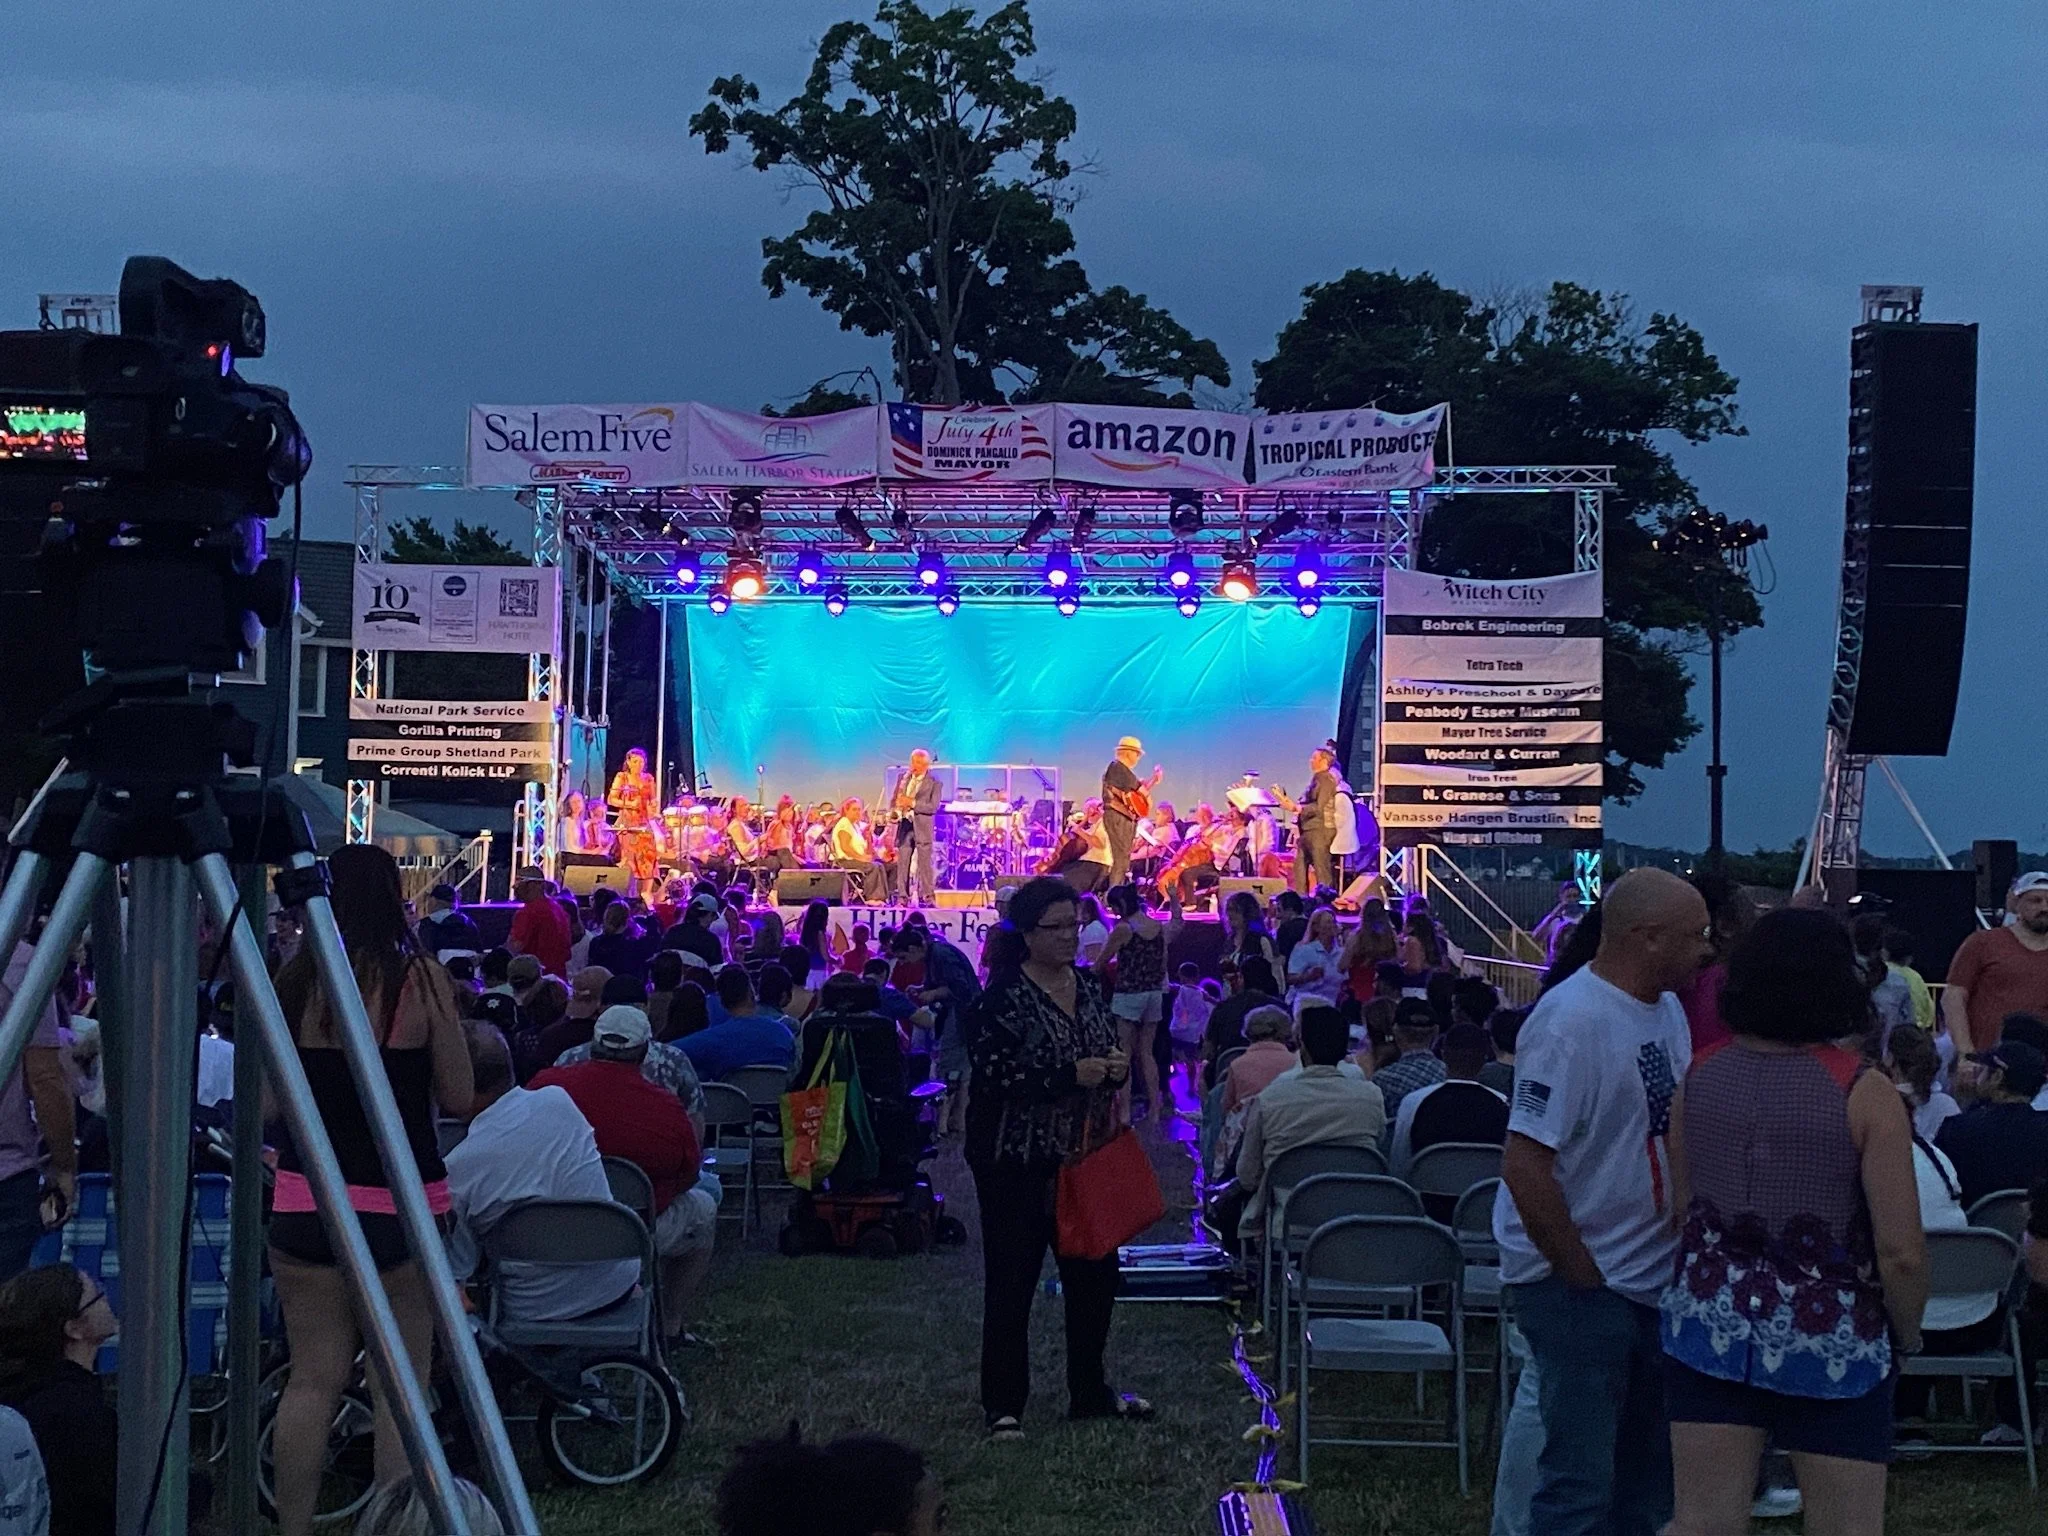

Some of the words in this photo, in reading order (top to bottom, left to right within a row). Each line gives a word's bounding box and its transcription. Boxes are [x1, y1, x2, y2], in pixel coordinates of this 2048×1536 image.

[484, 411, 673, 453] SalemFive
[927, 416, 974, 445] July
[979, 420, 1017, 446] 4th
[1066, 418, 1237, 462] amazon
[927, 446, 972, 458] DOMINICK
[974, 446, 1018, 459] PANGALLO
[1259, 439, 1347, 465] TROPICAL
[692, 463, 738, 478] SALEM
[745, 464, 803, 479] HARBOR
[810, 465, 872, 479] STATION
[934, 459, 1010, 469] MAYOR
[1316, 466, 1361, 477] Eastern
[1364, 463, 1399, 475] Bank
[1448, 584, 1502, 600] Witch
[1507, 584, 1549, 601] City
[1421, 619, 1475, 631] Bobrek
[1478, 619, 1566, 635] Engineering
[1466, 659, 1495, 671] Tetra
[1497, 659, 1523, 671] Tech
[1385, 684, 1444, 698] Ashley's
[1448, 687, 1521, 698] Preschool
[1526, 688, 1537, 697] &
[375, 703, 434, 716] National
[438, 706, 469, 716] Park
[473, 706, 525, 716] Service
[1405, 705, 1469, 720] Peabody
[1472, 706, 1515, 718] Essex
[1519, 706, 1581, 718] Museum
[398, 724, 445, 737] Gorilla
[447, 724, 502, 739] Printing
[1442, 727, 1476, 740] Mayer
[1478, 727, 1502, 739] Tree
[1505, 727, 1547, 739] Service
[356, 745, 396, 757] Prime
[400, 746, 442, 760] Group
[445, 747, 506, 759] Shetland
[510, 748, 542, 759] Park
[1424, 748, 1490, 761] Woodard
[1494, 749, 1505, 760] &
[1509, 748, 1561, 760] Curran
[380, 764, 438, 777] Correnti
[488, 765, 516, 778] LLP
[1467, 773, 1490, 782] Iron
[1493, 774, 1518, 782] Tree
[1422, 788, 1439, 801] N.
[1442, 789, 1505, 801] Granese
[1509, 790, 1520, 801] &
[1524, 790, 1561, 801] Sons
[1383, 811, 1444, 823] Vanasse
[1448, 812, 1505, 826] Hangen
[1573, 813, 1602, 824] Inc.
[850, 908, 952, 942] Hiler
